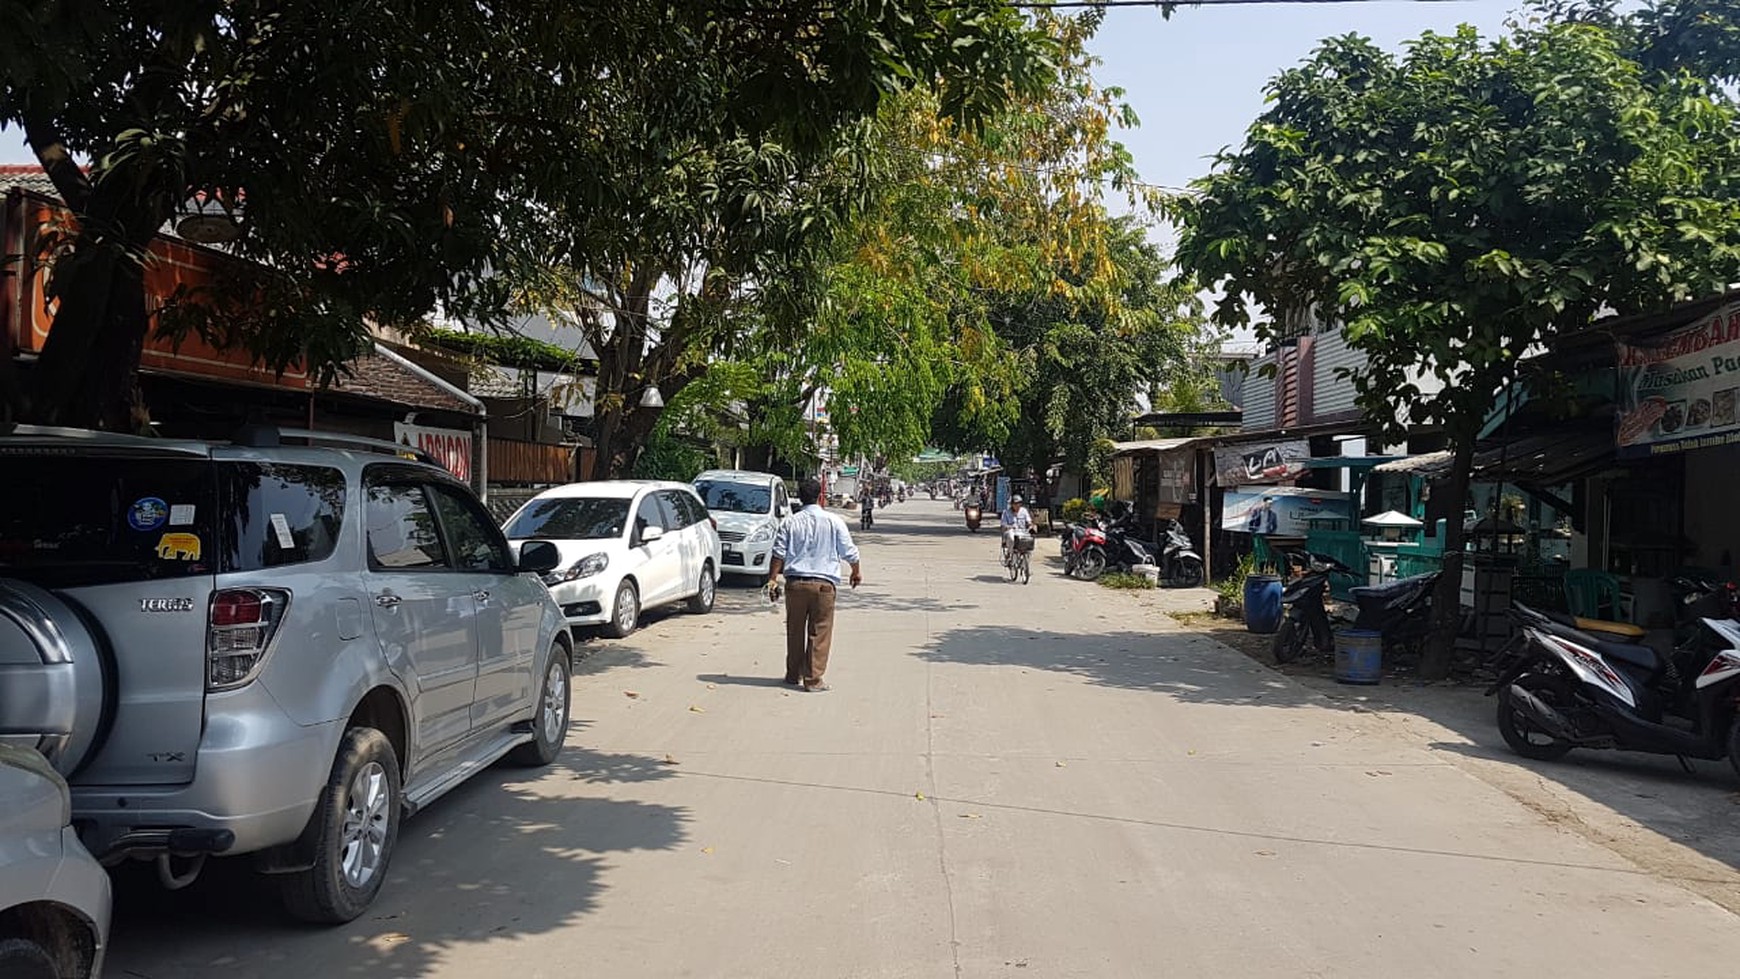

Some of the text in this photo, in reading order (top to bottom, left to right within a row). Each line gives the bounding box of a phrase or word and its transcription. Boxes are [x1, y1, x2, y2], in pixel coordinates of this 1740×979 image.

[1638, 355, 1740, 390] Masakan Pa
[1248, 449, 1277, 473] LA
[146, 751, 186, 762] TX
